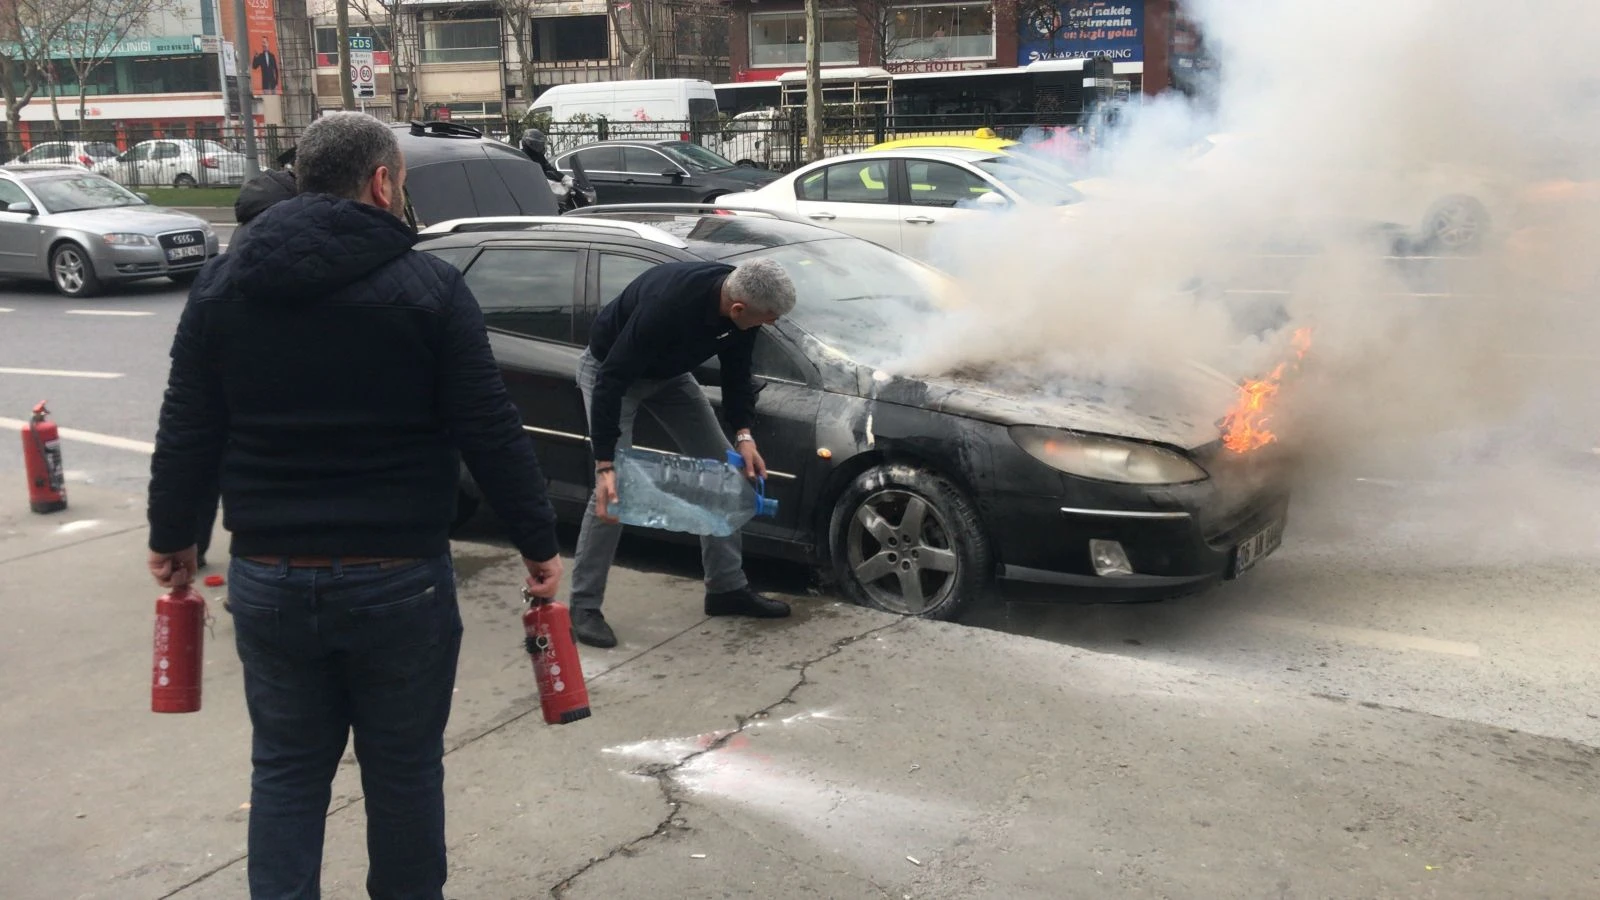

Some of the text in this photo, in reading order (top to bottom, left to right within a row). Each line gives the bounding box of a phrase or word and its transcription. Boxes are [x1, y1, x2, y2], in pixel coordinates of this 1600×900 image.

[1095, 6, 1132, 16] nakde
[1107, 28, 1137, 40] yolu!
[353, 40, 371, 48] EDS
[1074, 48, 1132, 58] FACTORING
[925, 61, 966, 72] HOTEL
[362, 69, 370, 78] 60
